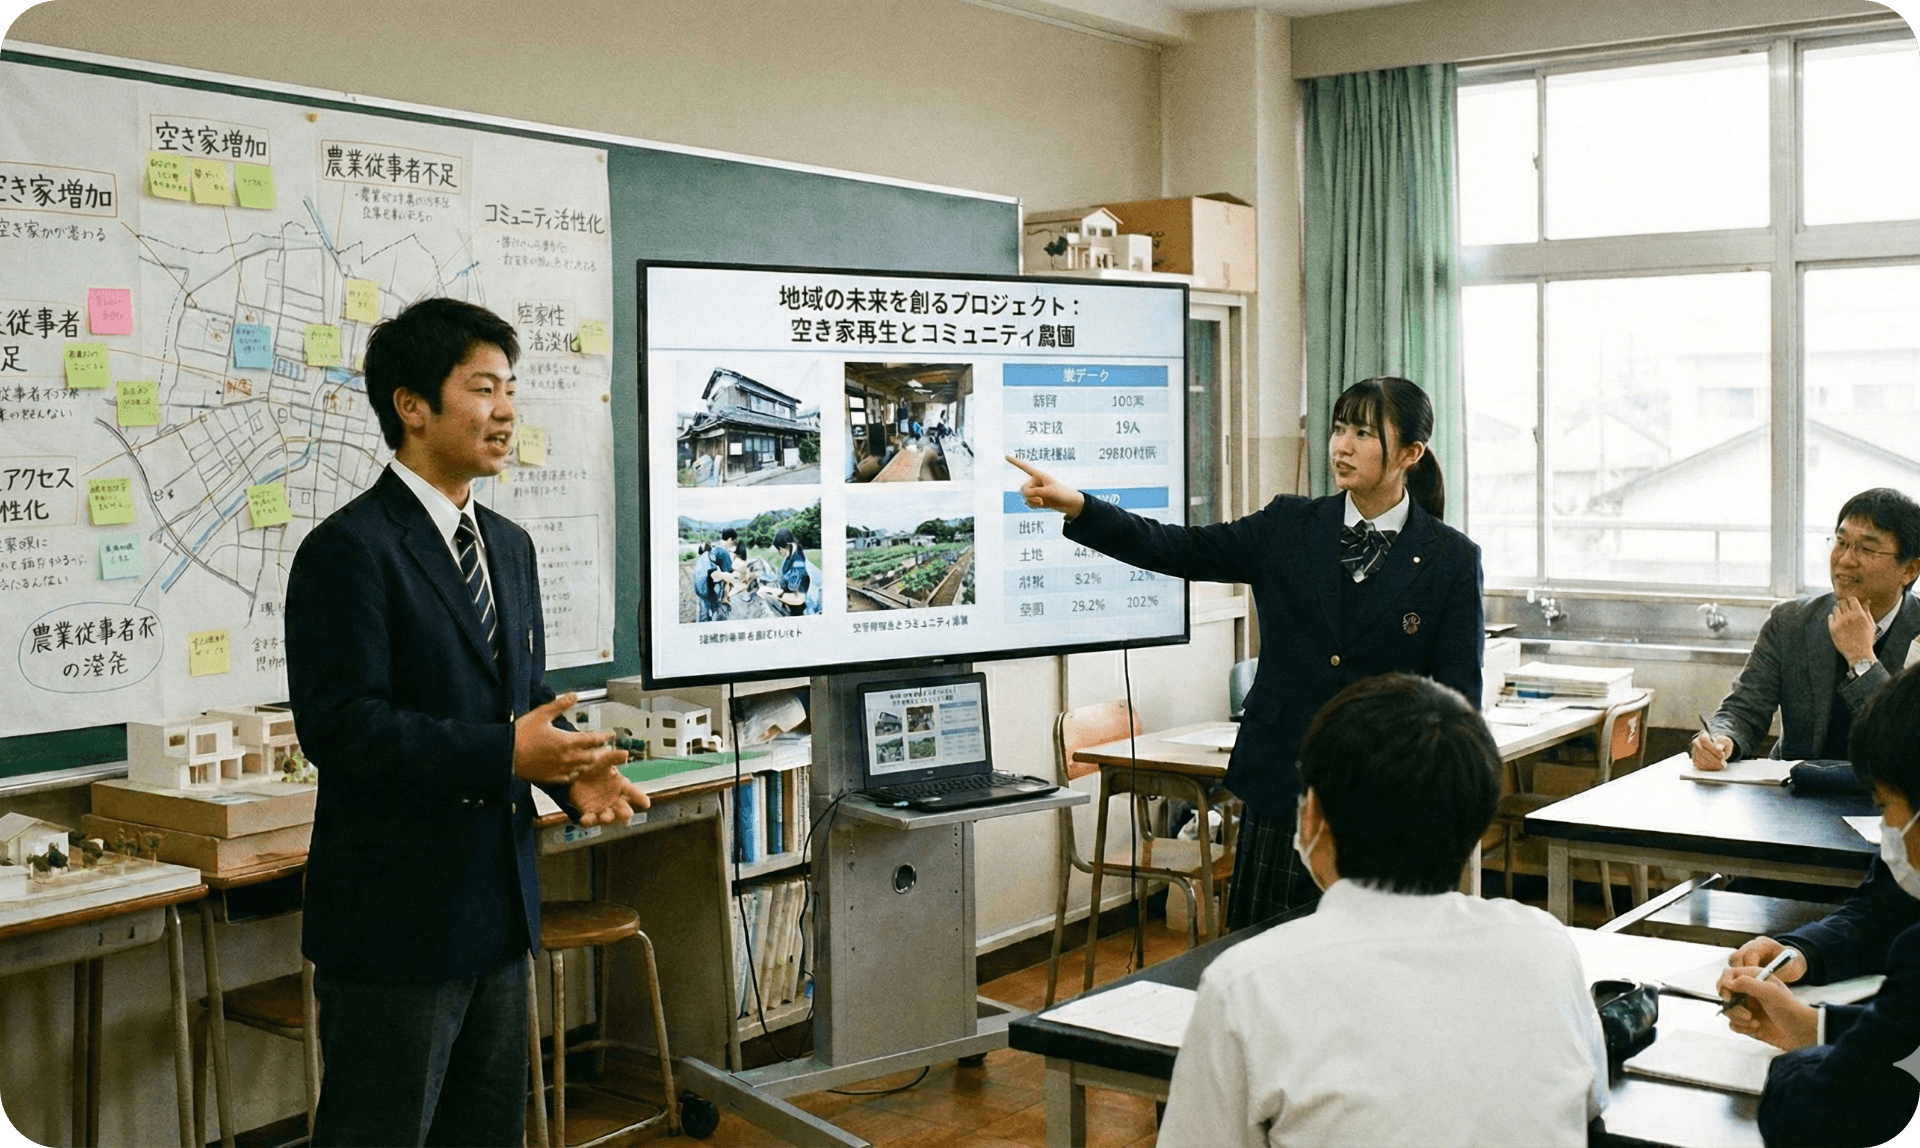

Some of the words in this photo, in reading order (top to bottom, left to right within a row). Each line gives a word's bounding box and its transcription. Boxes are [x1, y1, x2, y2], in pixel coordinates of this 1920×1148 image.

[156, 121, 267, 158] 空き家増加
[325, 145, 458, 188] 農業従事者不足
[484, 203, 605, 234] コミュニティ活性化
[0, 306, 80, 339] 従事者
[1, 345, 28, 372] 足
[0, 467, 75, 491] アクセス
